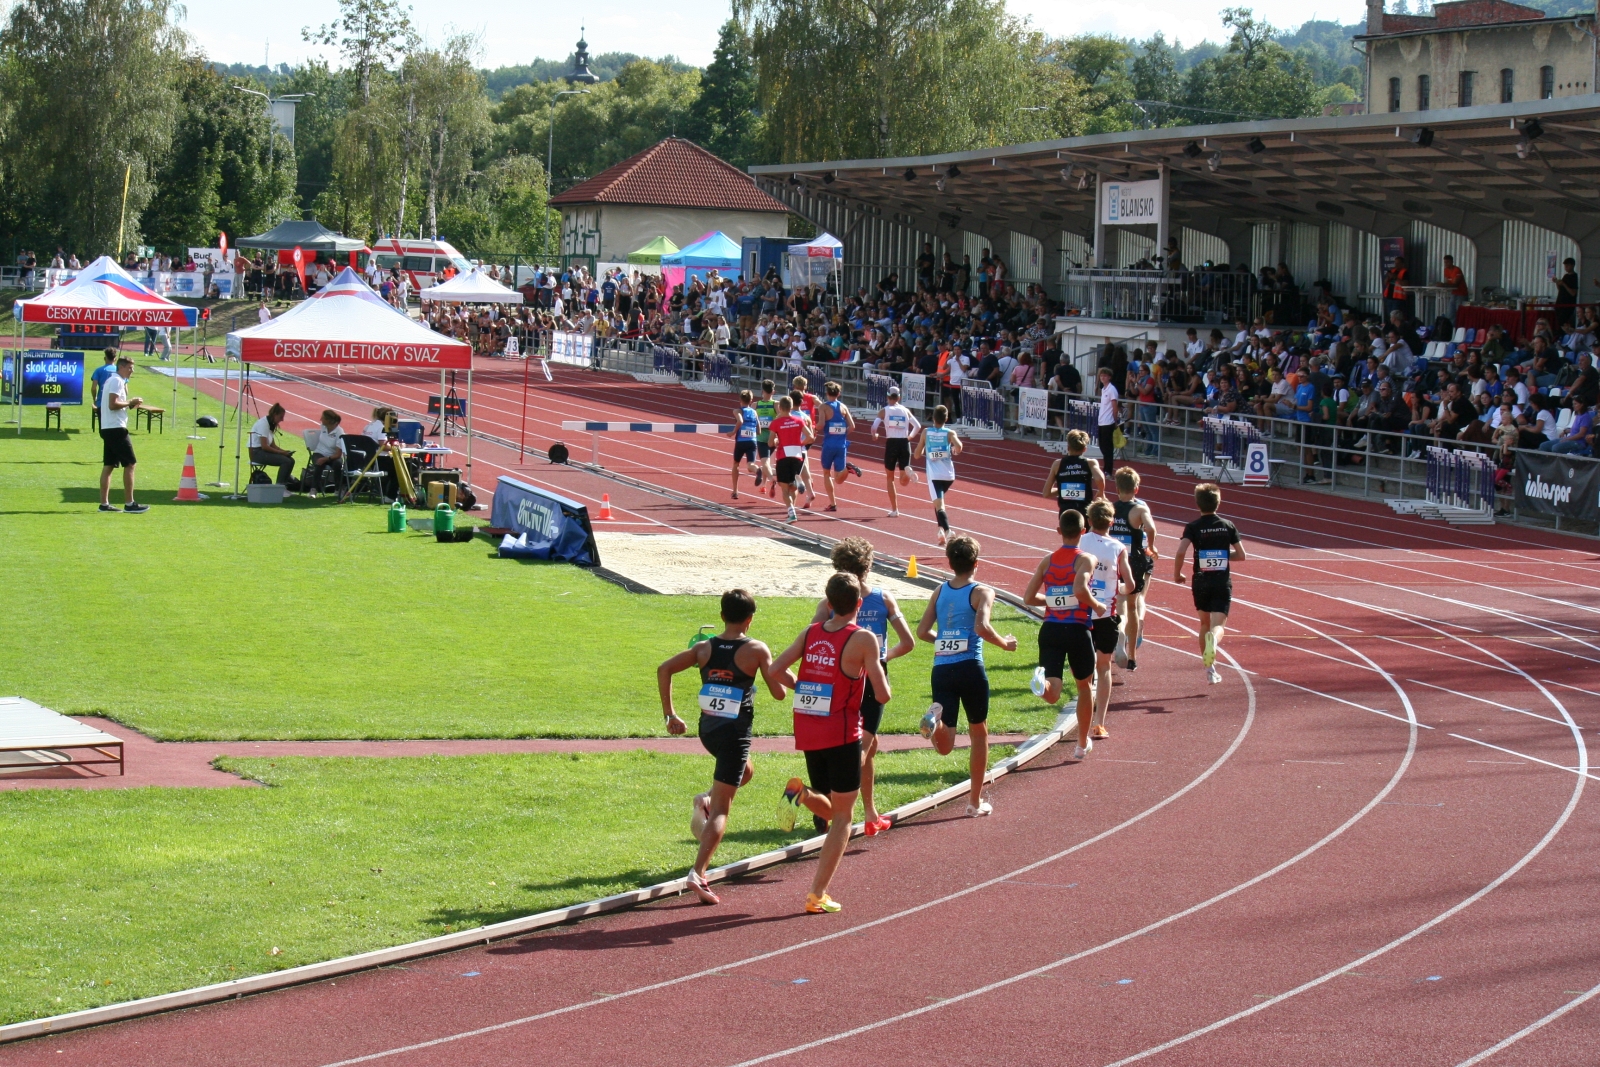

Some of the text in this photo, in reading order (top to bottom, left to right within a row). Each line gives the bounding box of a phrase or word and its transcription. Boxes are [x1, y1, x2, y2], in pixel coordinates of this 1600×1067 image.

[1120, 197, 1154, 217] BLANSKO
[46, 304, 173, 323] ČESKÝ ATLETICKÝ SVAZ
[202, 308, 209, 319] 2
[273, 340, 441, 363] ČESKÝ ATLETICKÝ SVAZ
[512, 340, 518, 352] 3
[25, 361, 46, 373] skok
[48, 361, 78, 377] daleký
[45, 373, 57, 383] Žáci
[40, 384, 61, 394] 15:30
[1025, 406, 1047, 421] BLANSKO
[1250, 450, 1265, 473] 8
[1065, 489, 1080, 498] 263
[1525, 472, 1572, 507] inkospor
[1206, 558, 1224, 567] 537
[1055, 596, 1066, 606] 61
[939, 640, 960, 650] 345
[709, 685, 726, 694] ČESKÁ
[800, 683, 816, 691] ČESKÁ
[709, 697, 726, 711] 45
[799, 695, 819, 705] 497
